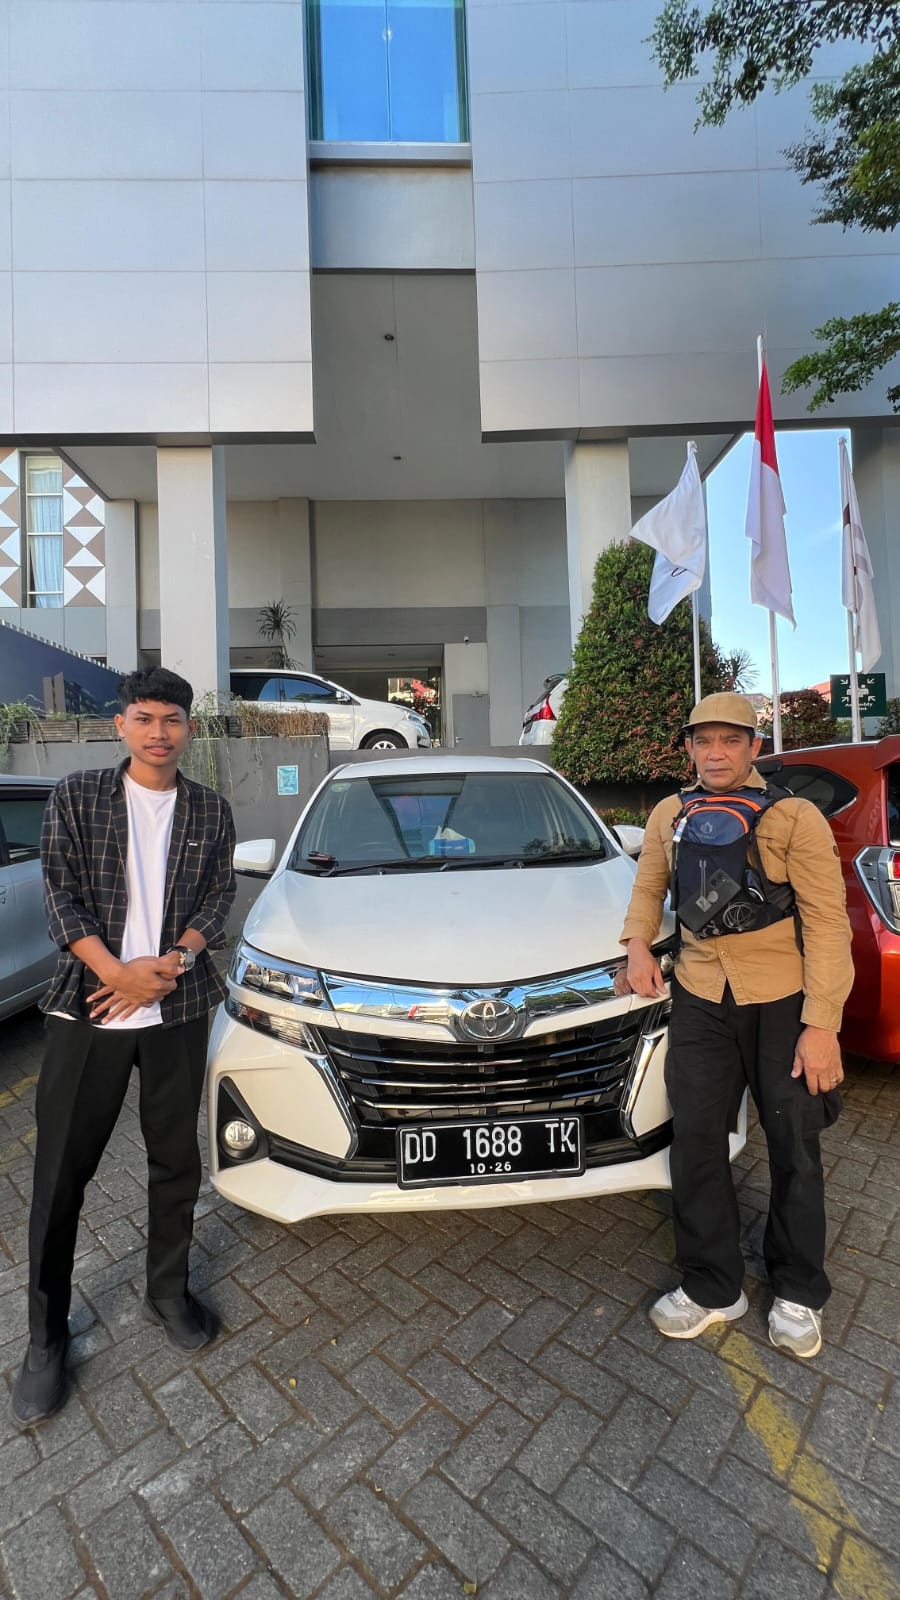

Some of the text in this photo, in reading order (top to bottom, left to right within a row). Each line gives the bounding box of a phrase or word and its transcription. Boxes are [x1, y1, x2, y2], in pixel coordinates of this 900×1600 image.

[404, 1121, 576, 1165] DD 1688 TK
